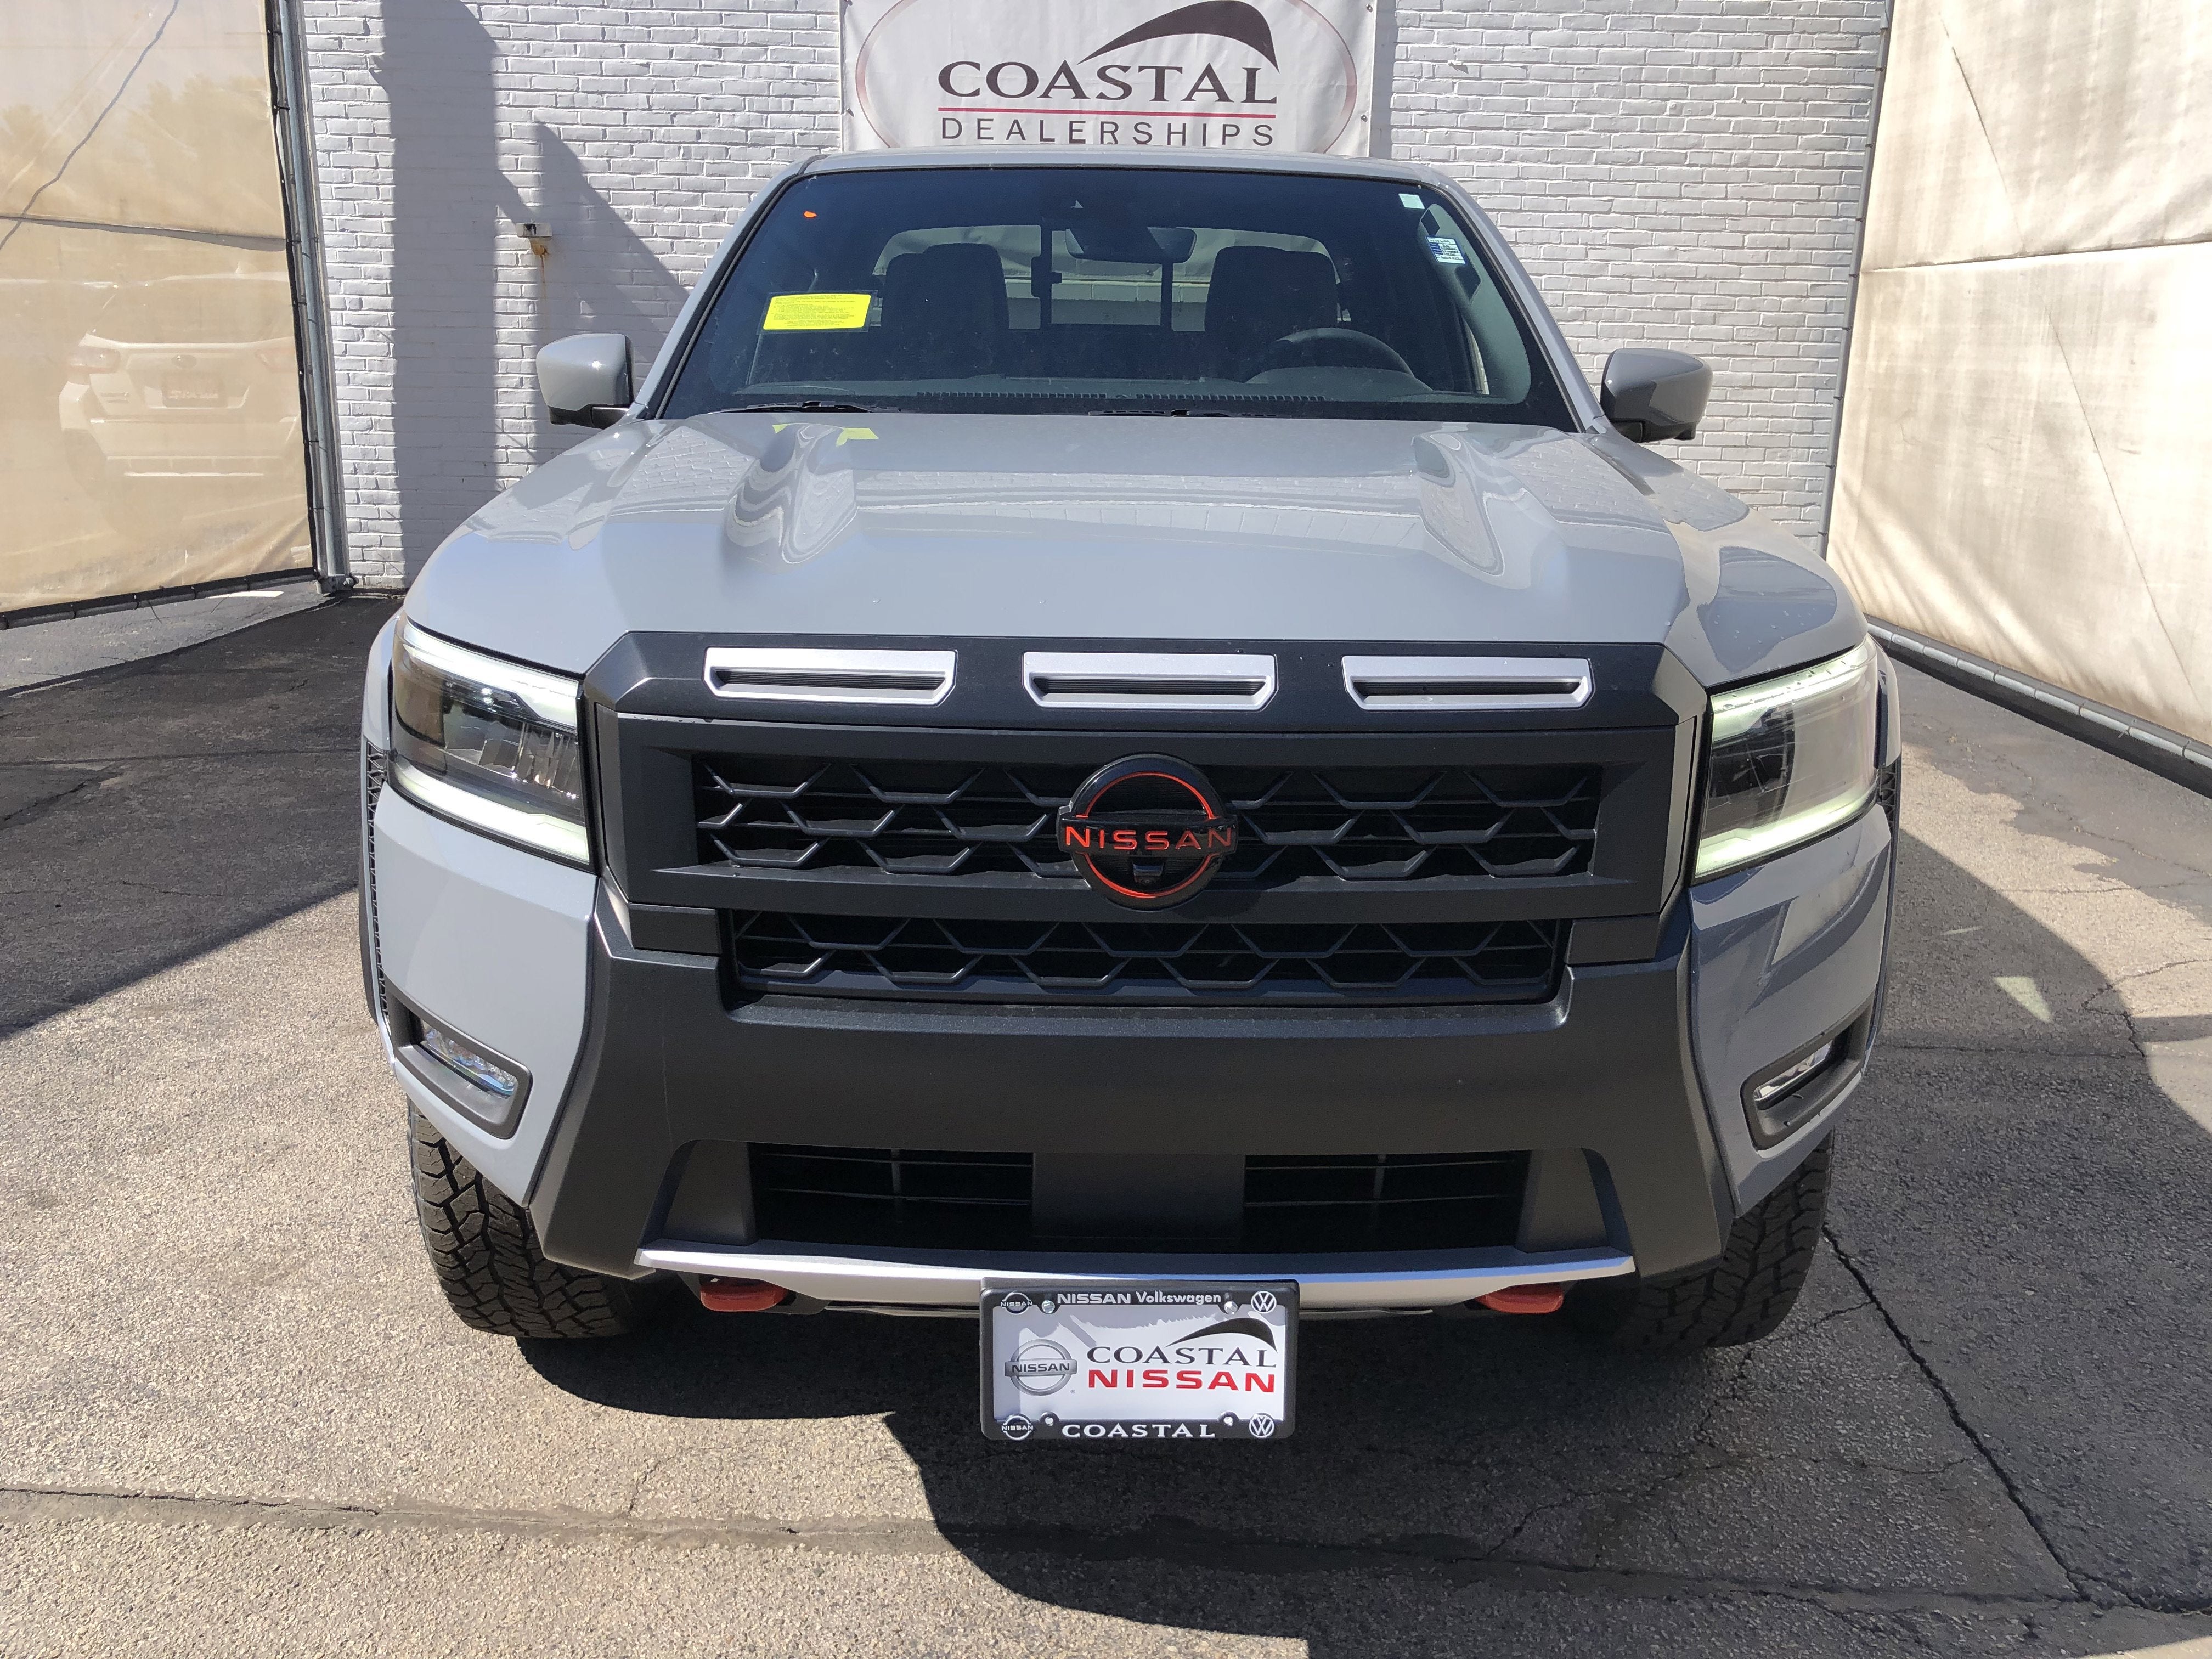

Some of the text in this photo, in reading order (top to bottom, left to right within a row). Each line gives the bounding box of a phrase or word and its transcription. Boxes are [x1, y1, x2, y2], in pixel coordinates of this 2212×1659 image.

[937, 59, 1278, 104] COASTAL
[941, 117, 1274, 147] DEALERSHIPS
[1065, 826, 1232, 850] NISSAN
[1057, 1291, 1222, 1305] NISSAN Volkswagen
[1012, 1362, 1070, 1373] NISSAN
[1087, 1345, 1277, 1368] COASTAL
[1088, 1369, 1275, 1393] NISSAN
[1062, 1423, 1216, 1438] COASTAL
